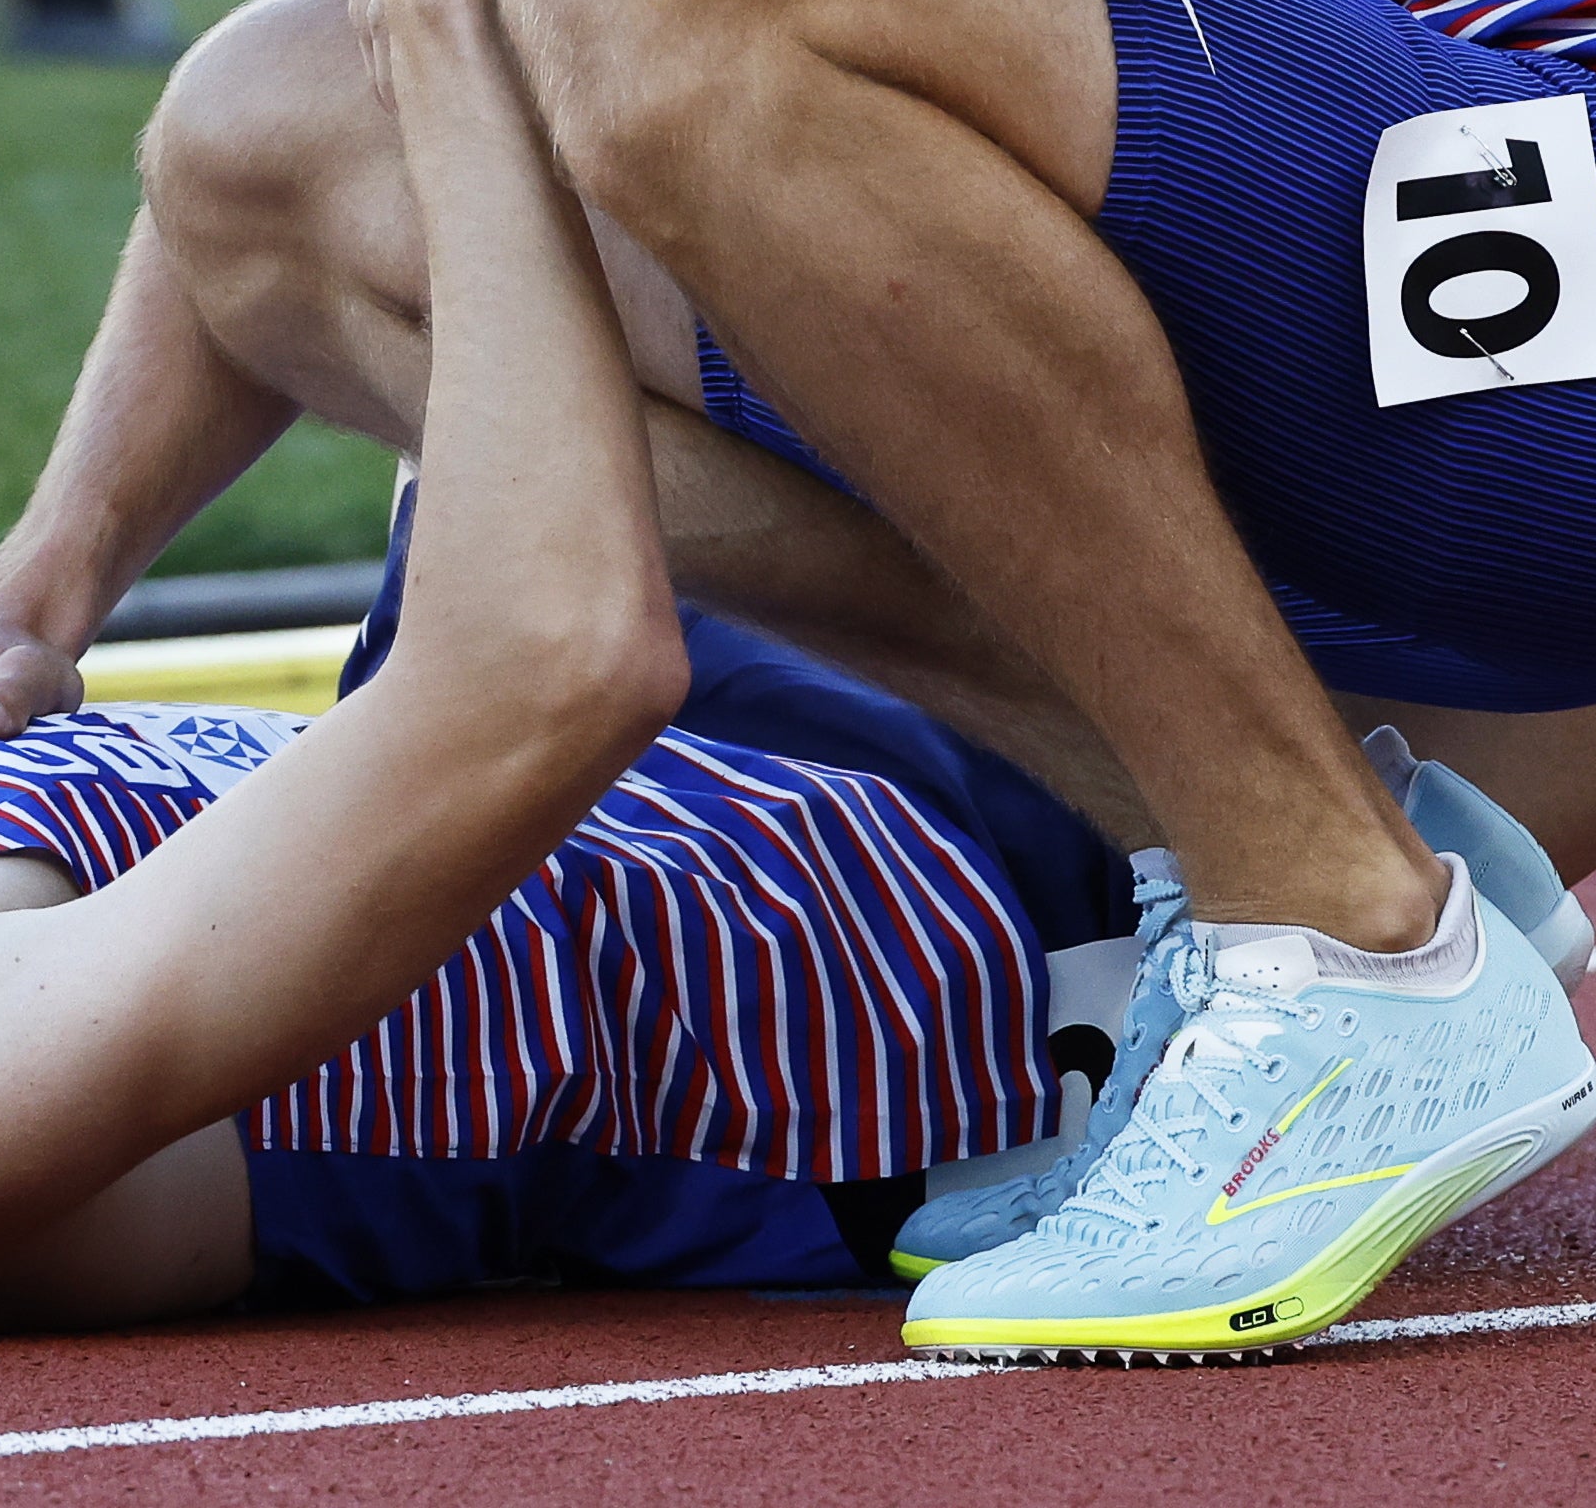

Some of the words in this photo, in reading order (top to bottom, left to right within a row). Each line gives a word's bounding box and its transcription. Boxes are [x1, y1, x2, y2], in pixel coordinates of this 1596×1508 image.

[1397, 138, 1560, 359] 10
[1562, 1086, 1587, 1111] WIRE
[1222, 1127, 1280, 1197] BROOKS
